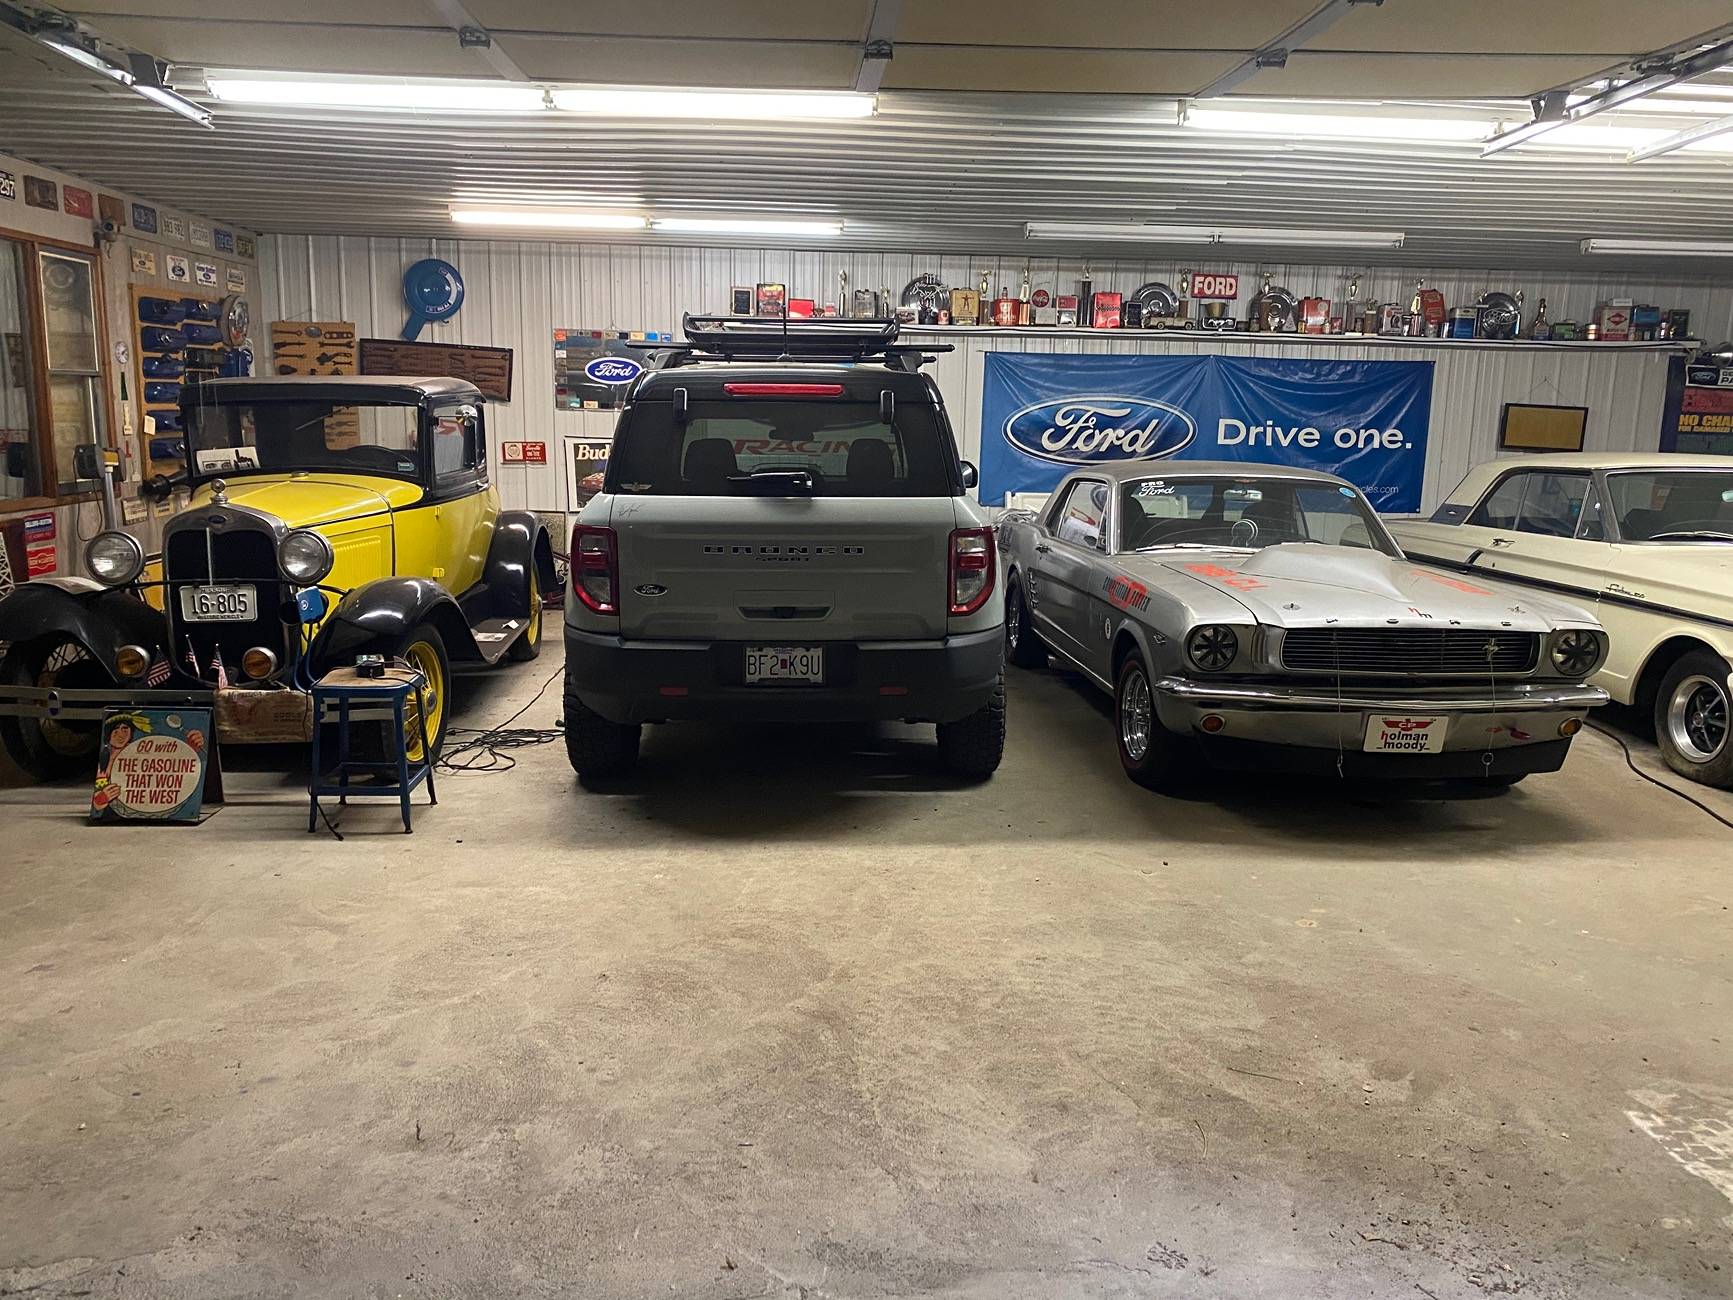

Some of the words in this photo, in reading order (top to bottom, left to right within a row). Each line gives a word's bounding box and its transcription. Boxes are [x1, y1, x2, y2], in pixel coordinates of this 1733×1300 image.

[1194, 276, 1237, 295] FORD
[594, 362, 633, 376] Ford
[1680, 415, 1699, 425] NO
[1702, 415, 1733, 426] CHA
[1041, 405, 1159, 454] Ford
[1218, 418, 1320, 449] Drive
[1334, 426, 1413, 450] one.
[576, 444, 610, 460] Bud
[733, 439, 849, 455] RACIN
[1138, 485, 1175, 497] Ford
[703, 545, 865, 555] BRONCO
[640, 585, 661, 594] Ford
[191, 593, 248, 614] 16-805
[747, 655, 779, 675] BF2
[788, 655, 820, 675] K9U
[1380, 730, 1428, 742] holman
[137, 740, 153, 753] GO
[155, 741, 178, 753] with
[1383, 740, 1426, 751] moody
[118, 758, 138, 773] THE
[141, 759, 196, 773] GASOLINE
[125, 774, 153, 789] THAT
[156, 775, 183, 789] WON
[125, 789, 146, 804] THE
[149, 789, 180, 804] WEST
